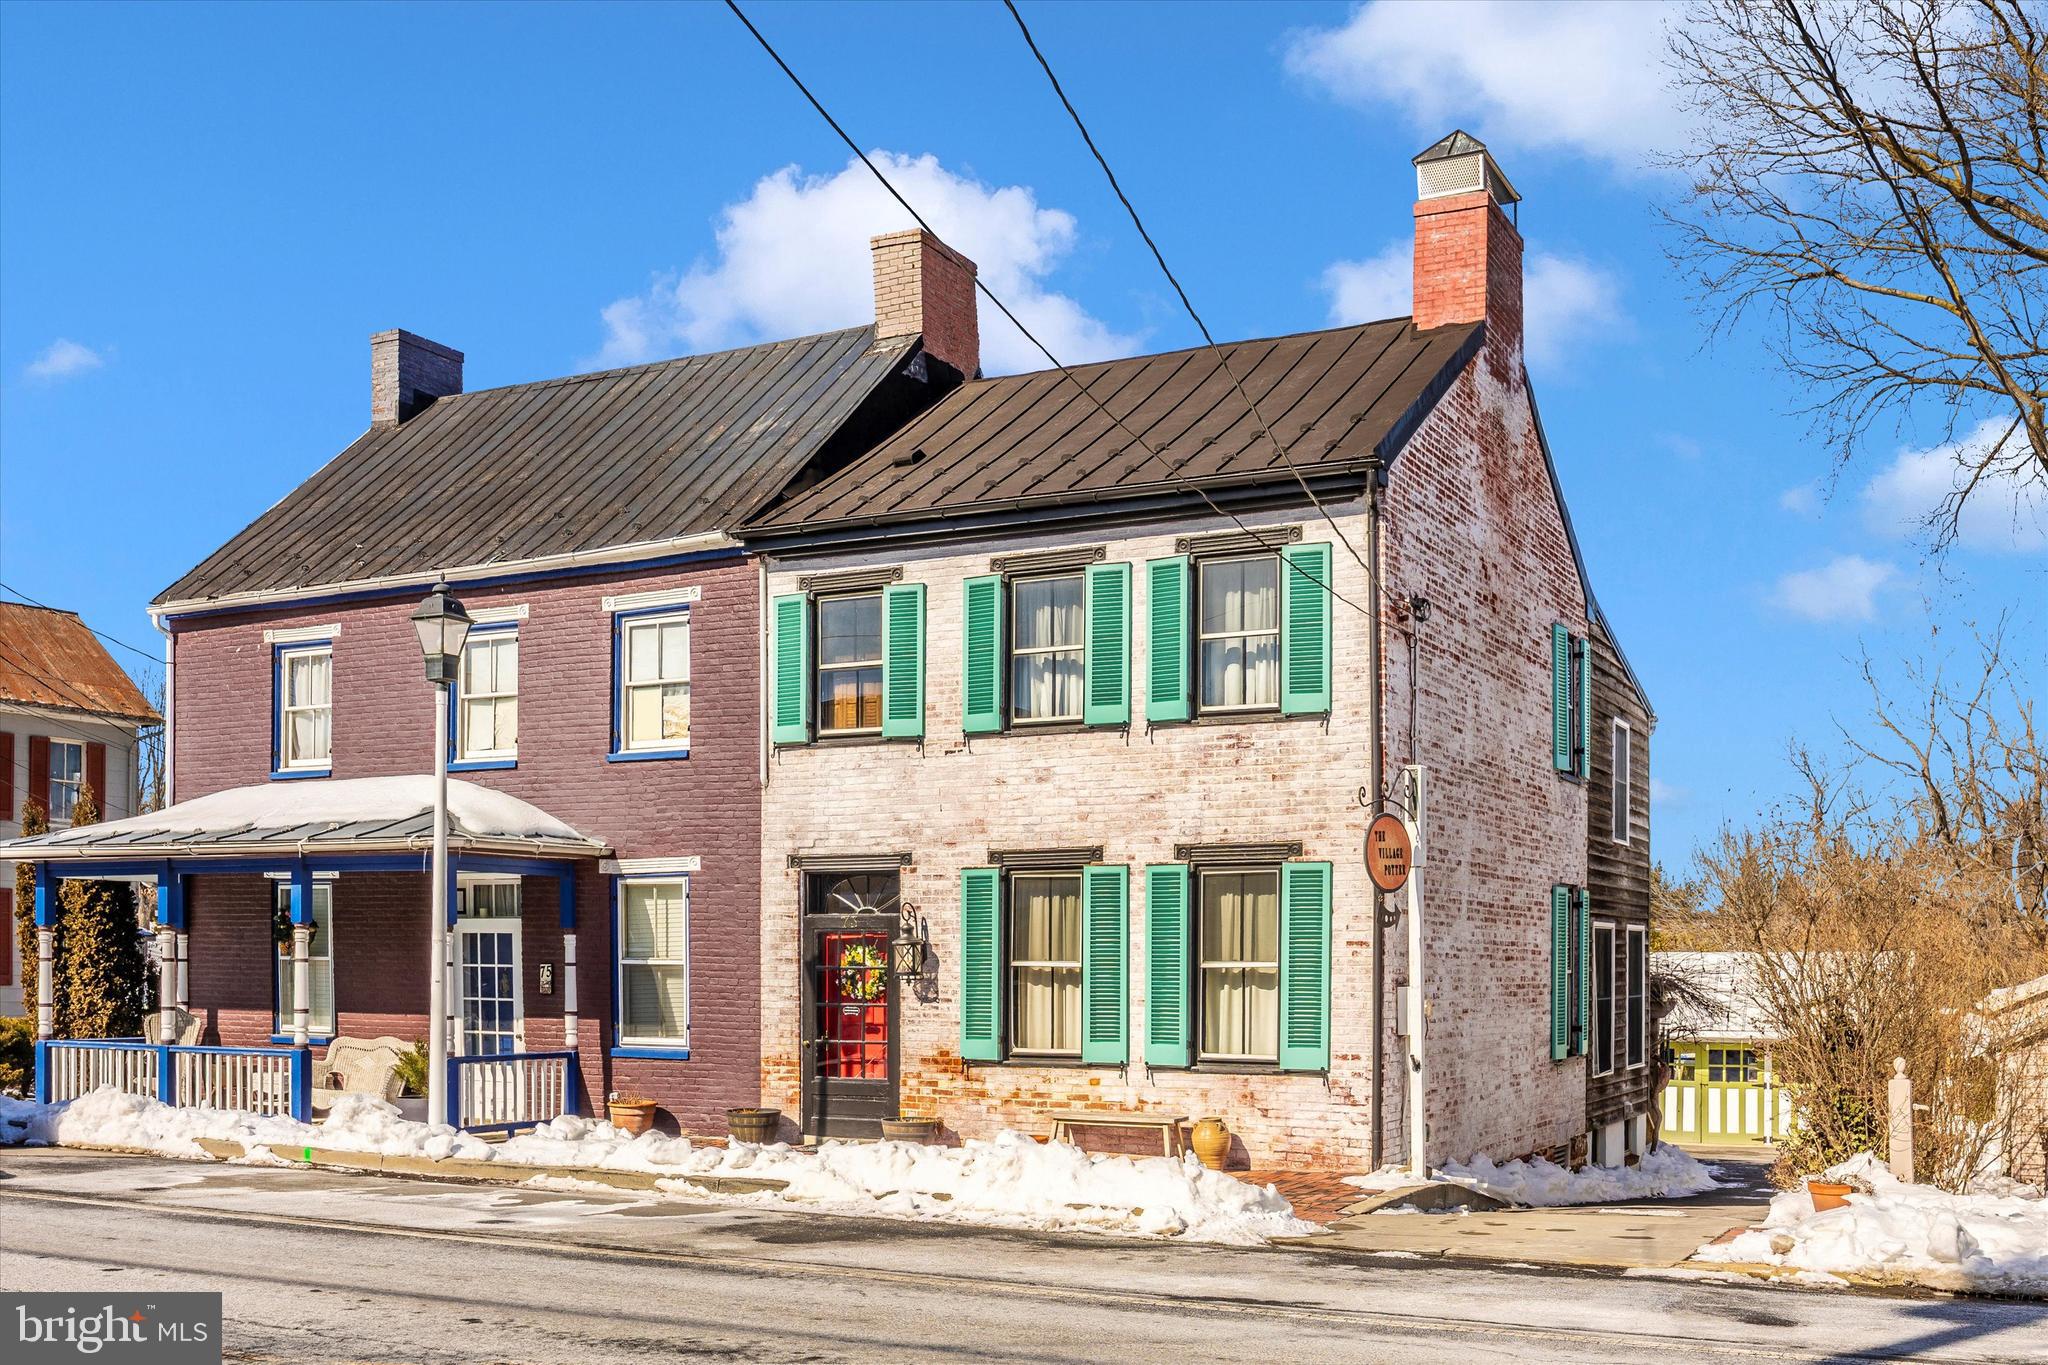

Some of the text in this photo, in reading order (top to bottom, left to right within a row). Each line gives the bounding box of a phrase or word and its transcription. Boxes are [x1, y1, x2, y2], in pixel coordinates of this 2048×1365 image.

[1374, 830, 1386, 842] THE
[1378, 847, 1404, 859] VILLAGE
[1384, 864, 1406, 876] POTTER
[540, 965, 552, 979] 75
